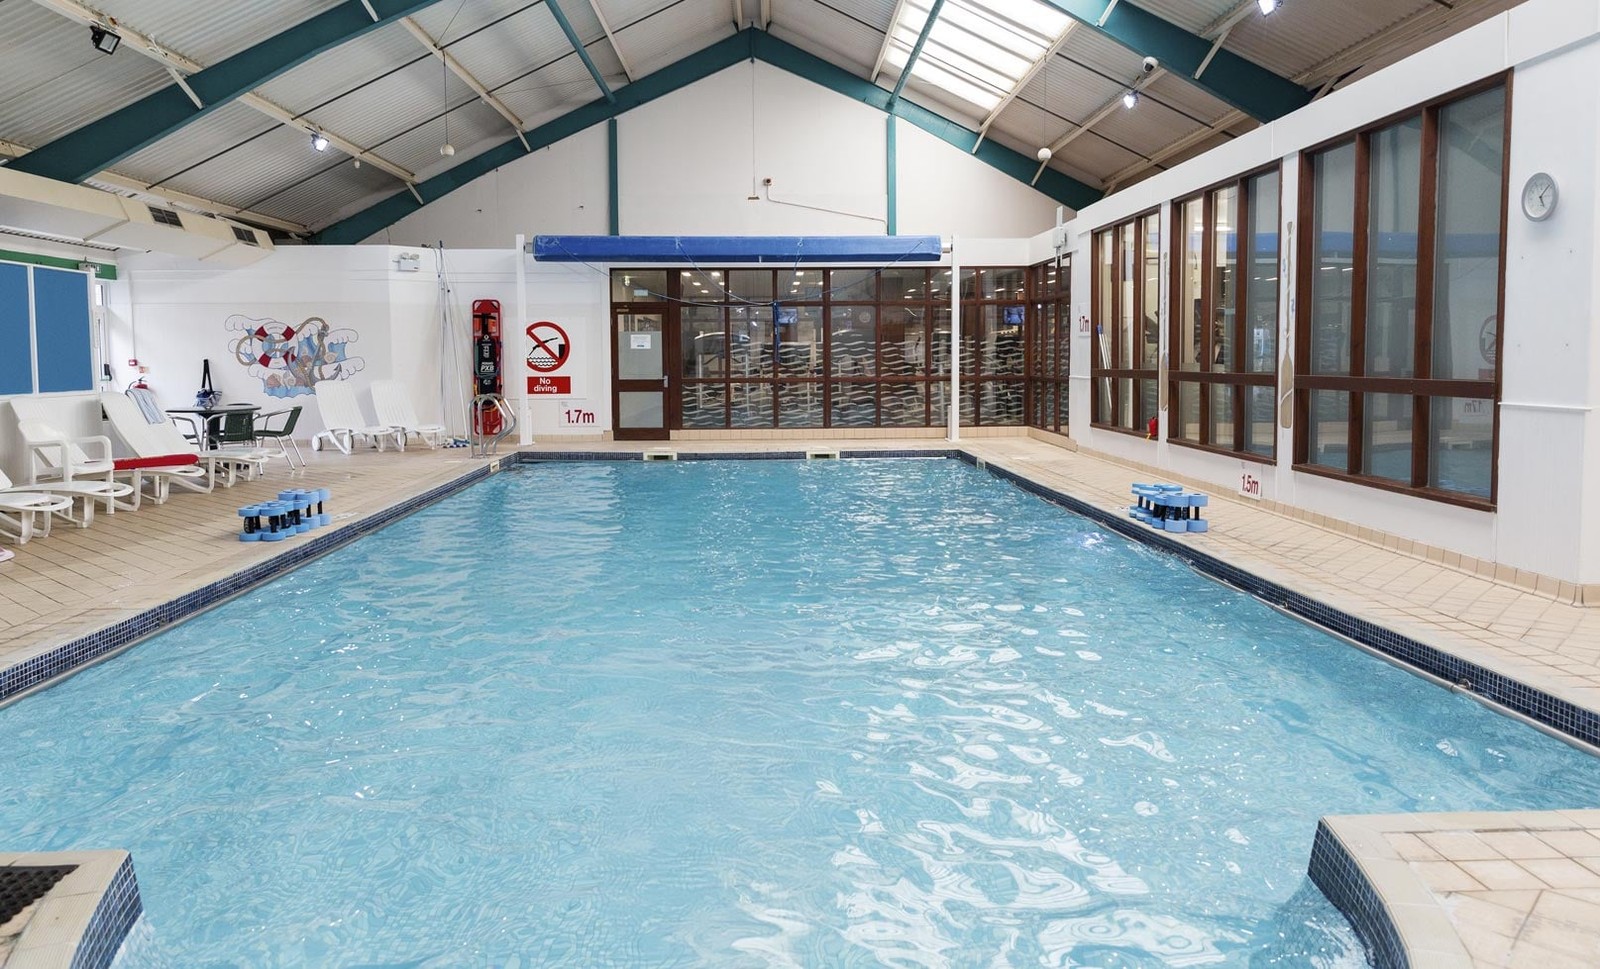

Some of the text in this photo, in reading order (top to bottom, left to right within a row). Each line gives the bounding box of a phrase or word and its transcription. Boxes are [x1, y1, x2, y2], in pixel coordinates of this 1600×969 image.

[539, 377, 551, 385] No
[533, 385, 558, 393] diving
[565, 409, 595, 424] 1.7m
[1242, 474, 1259, 495] 1.5m
